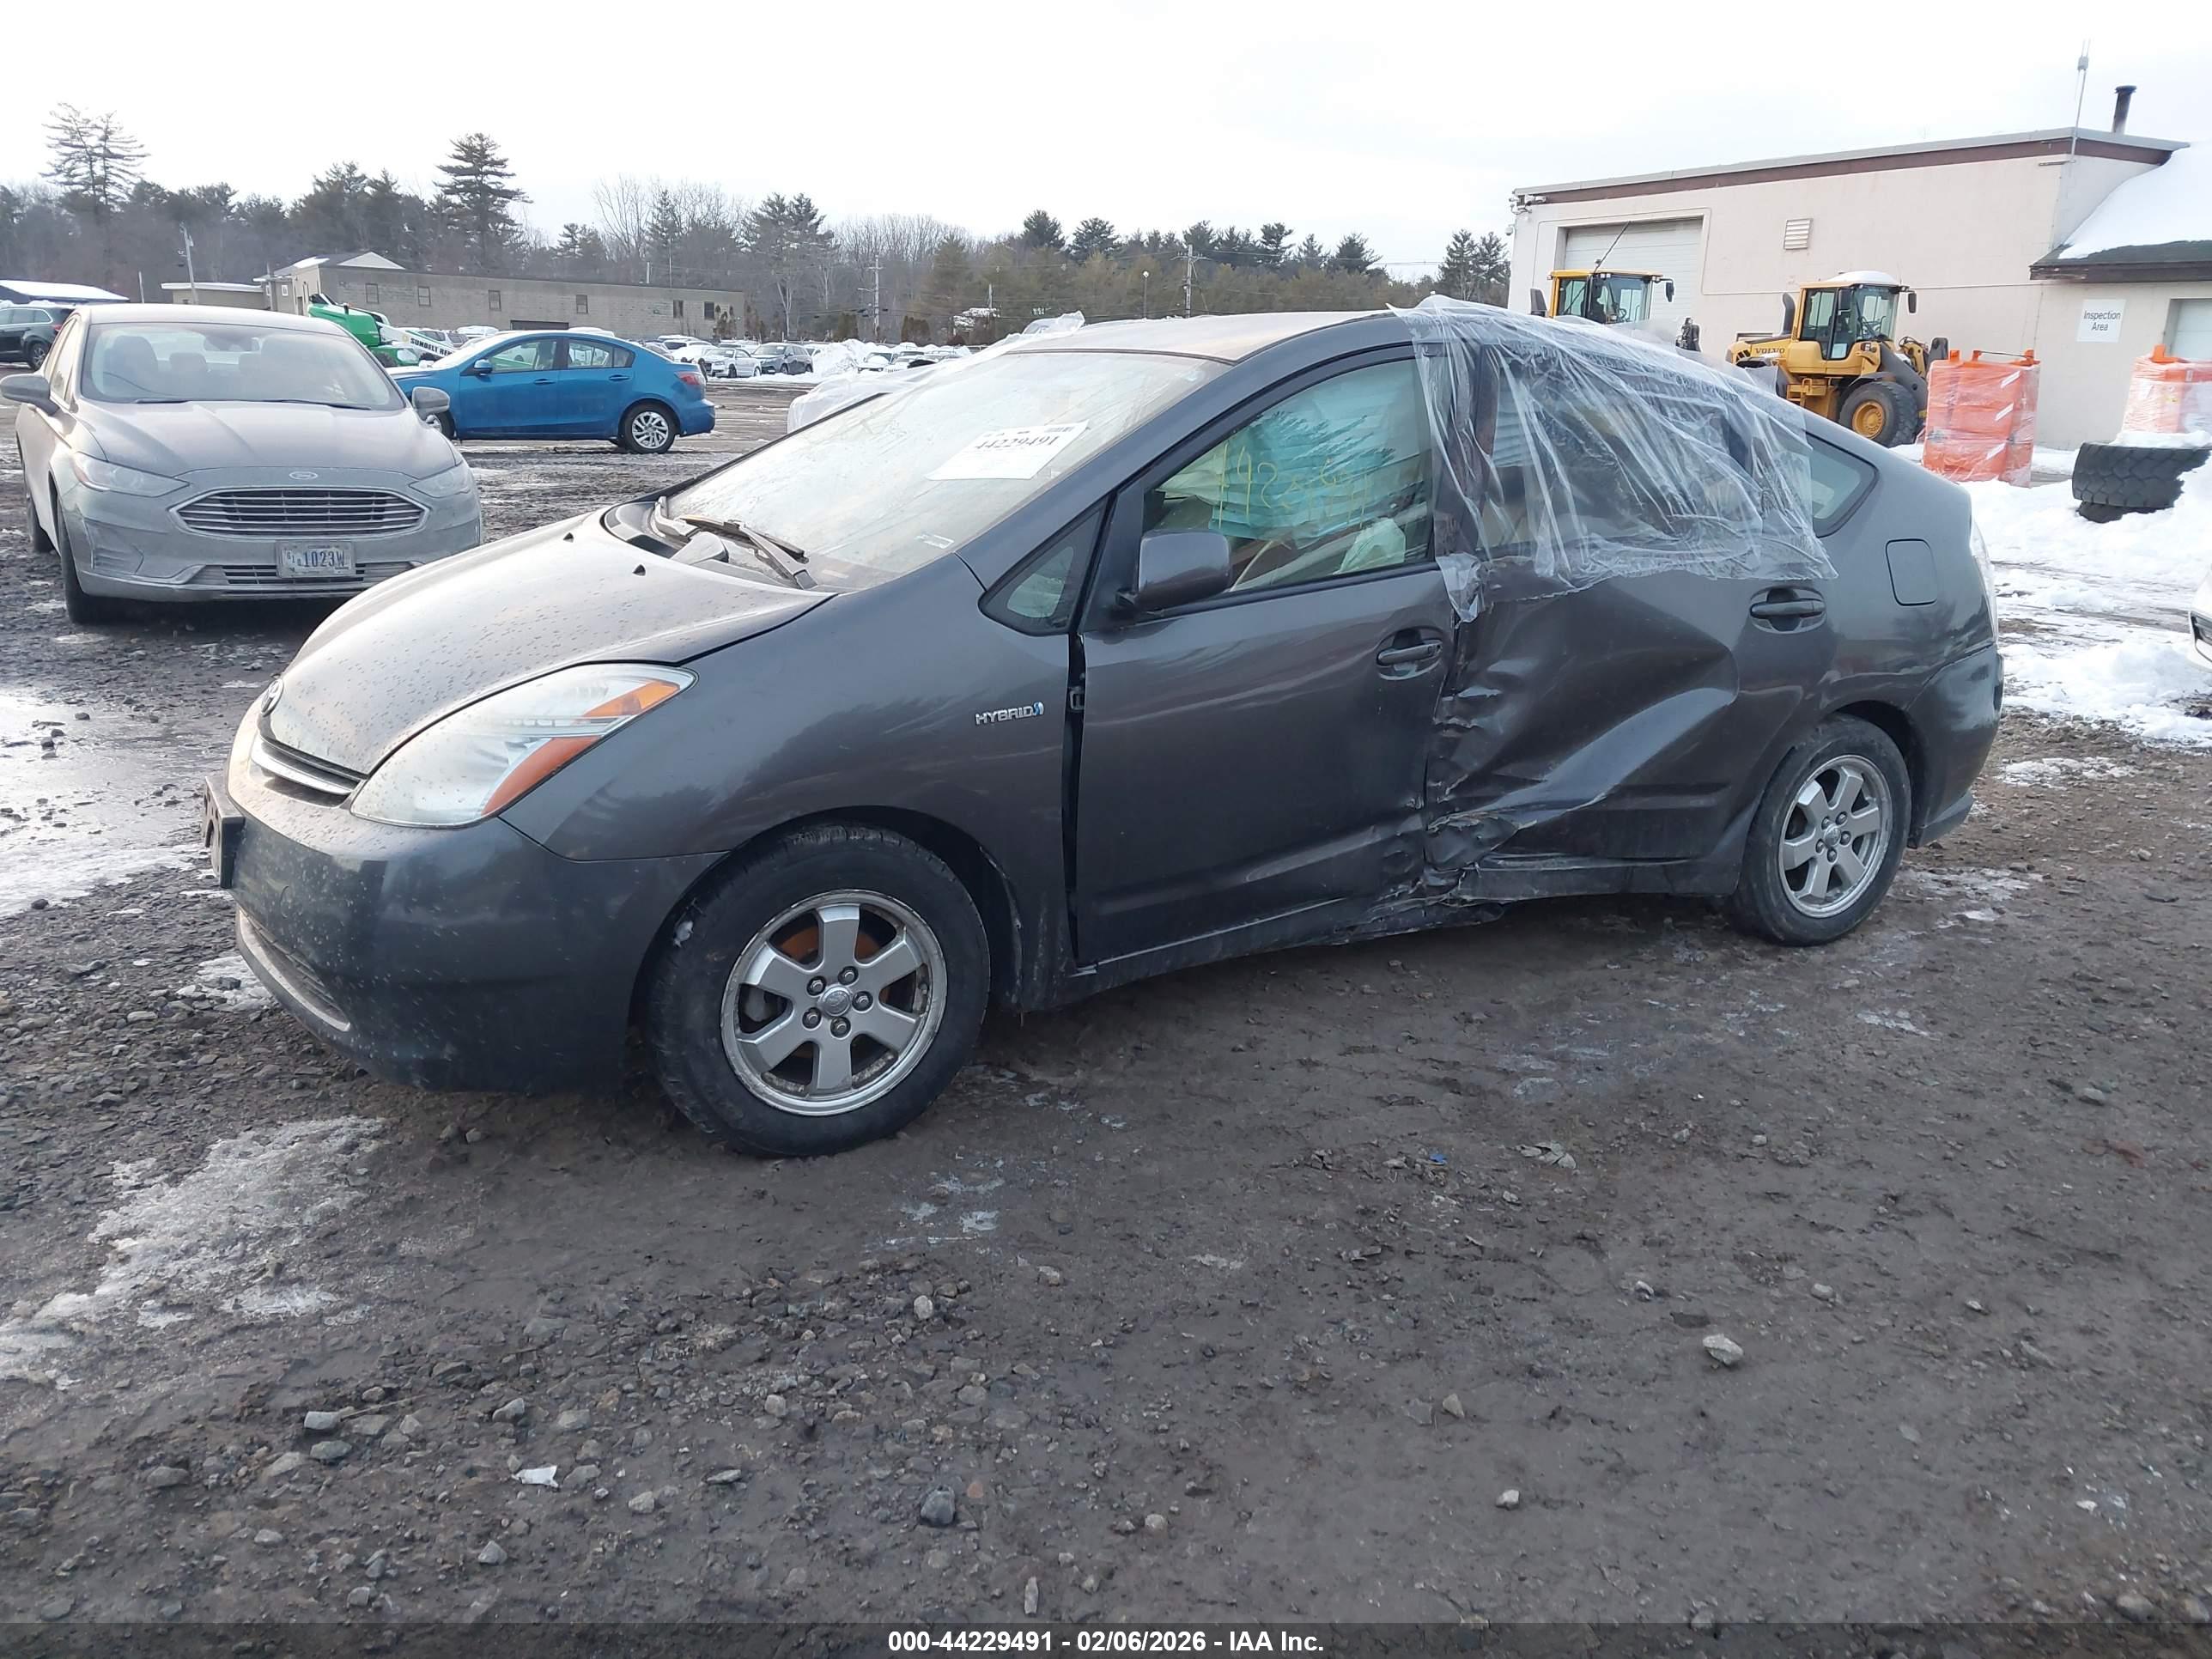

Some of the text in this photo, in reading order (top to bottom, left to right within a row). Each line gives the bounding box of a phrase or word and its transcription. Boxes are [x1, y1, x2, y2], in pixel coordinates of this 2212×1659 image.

[2083, 310, 2121, 322] Inspection
[2091, 322, 2109, 331] Area
[410, 337, 438, 353] SUNBELT
[975, 434, 1060, 450] 44229491
[303, 550, 345, 568] 1023W
[975, 705, 1034, 726] HYBRID
